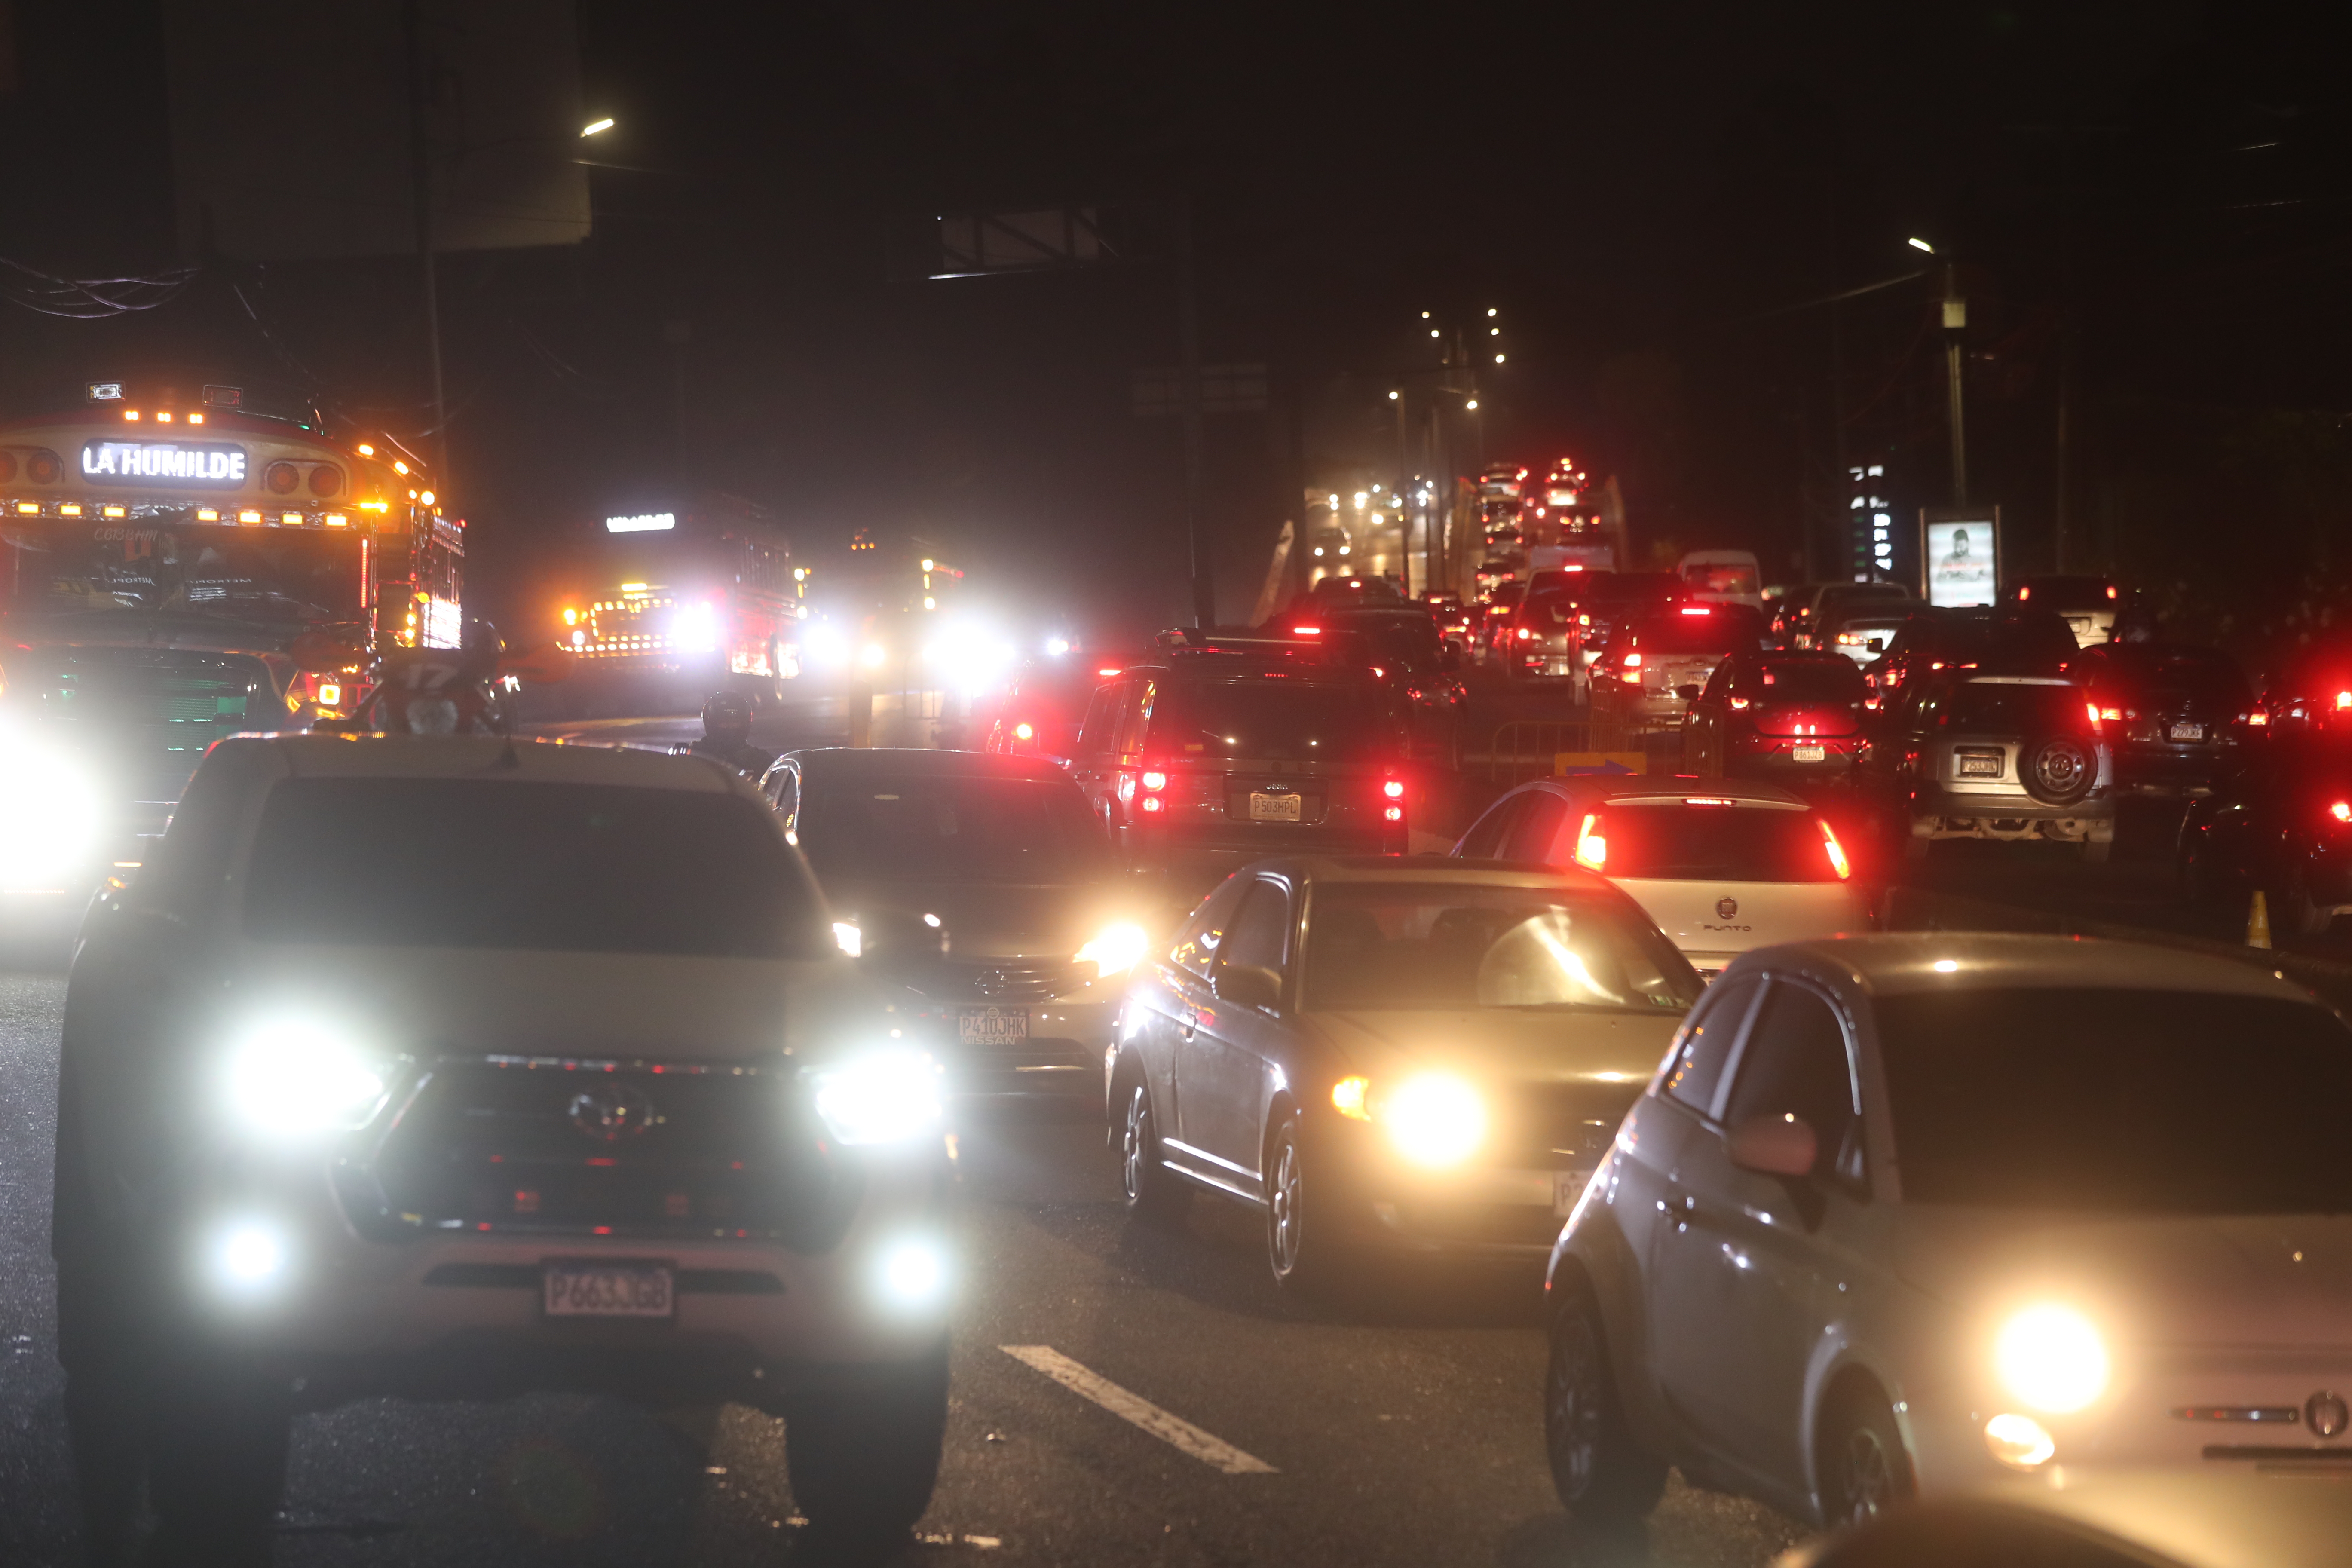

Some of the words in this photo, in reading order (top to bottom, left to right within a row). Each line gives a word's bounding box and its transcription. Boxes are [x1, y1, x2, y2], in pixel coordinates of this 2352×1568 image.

[83, 447, 115, 474] LA
[122, 449, 245, 480] HUMILDE
[962, 1017, 1024, 1035] P410JHK
[961, 1036, 1015, 1045] NISSAN
